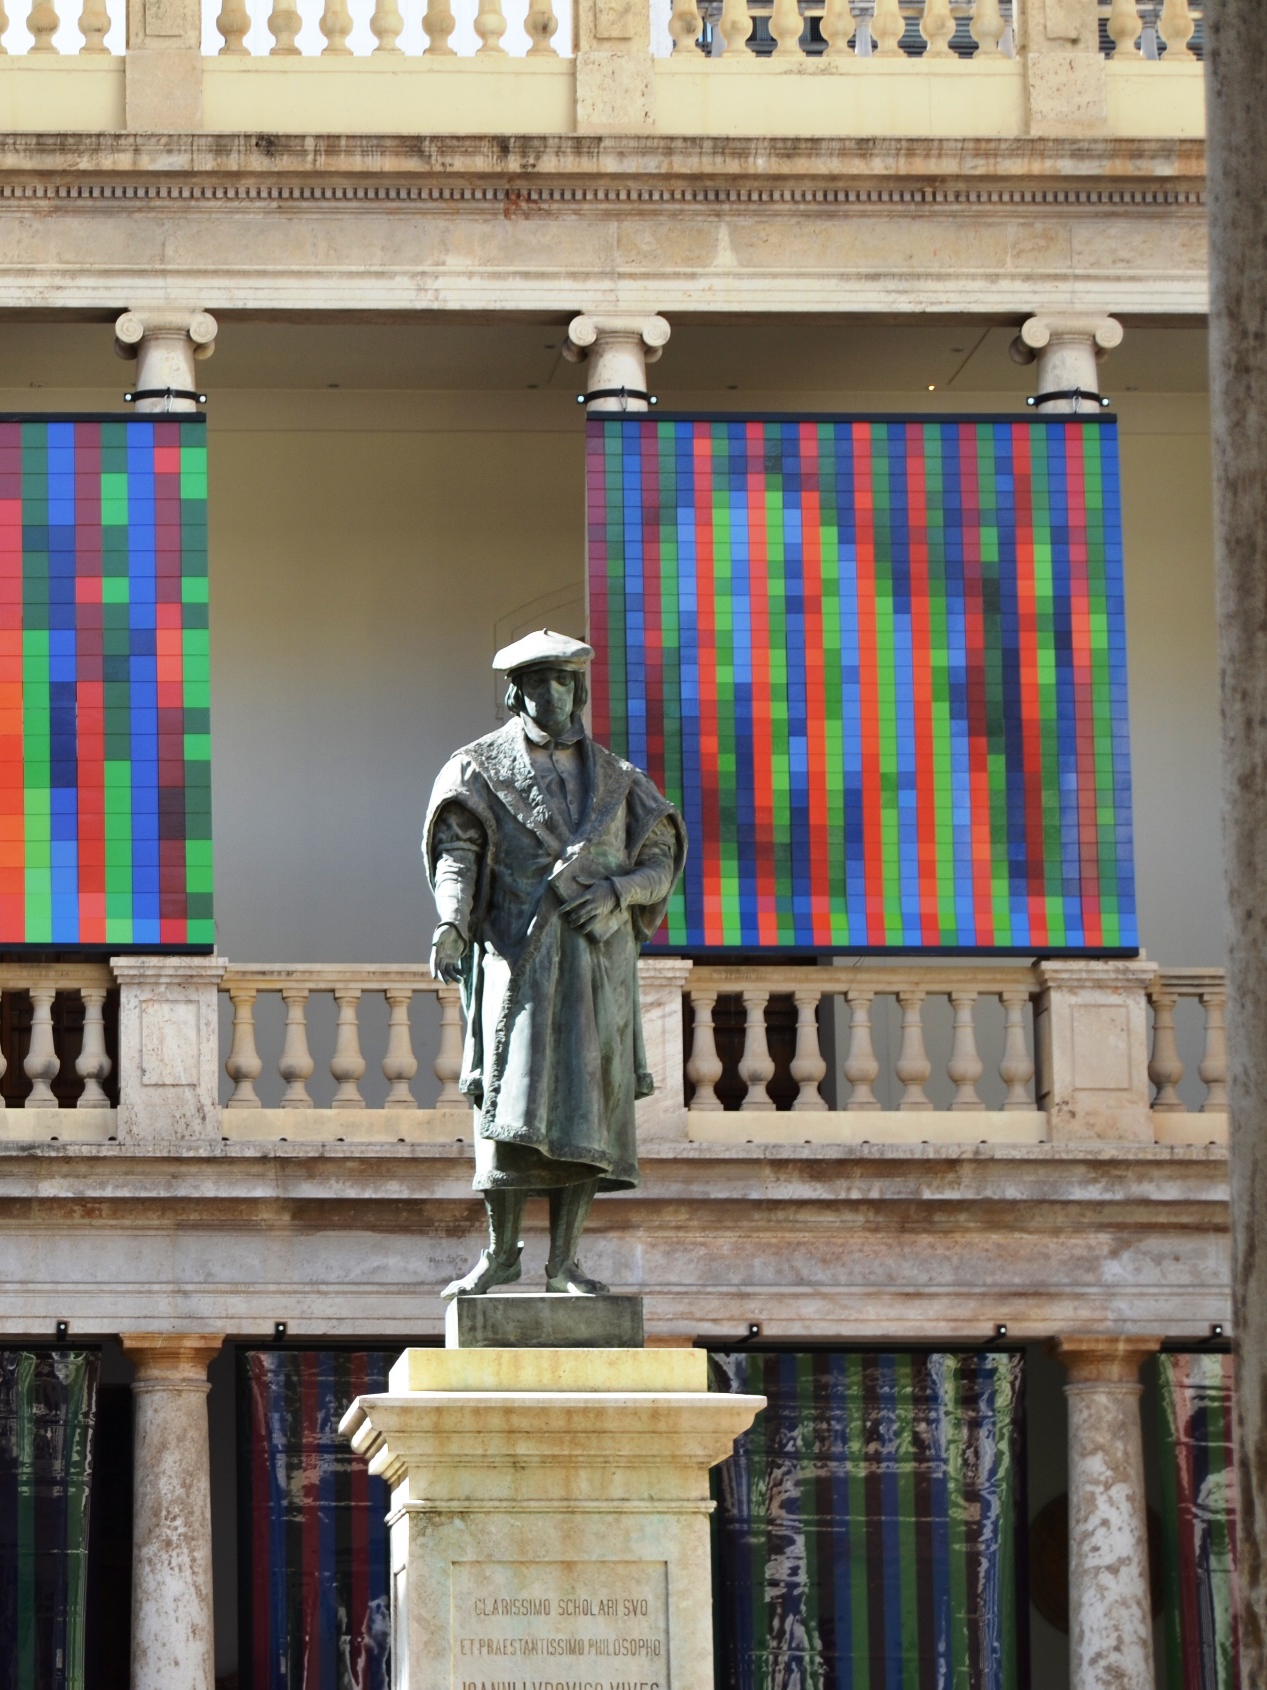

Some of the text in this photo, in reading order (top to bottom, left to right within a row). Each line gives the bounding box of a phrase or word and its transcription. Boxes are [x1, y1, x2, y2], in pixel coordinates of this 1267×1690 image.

[474, 1598, 648, 1617] CLARISSIMO SCHOLARI SVO
[460, 1638, 661, 1657] ET PRAESTANTISSIMO PHILOSOPHO
